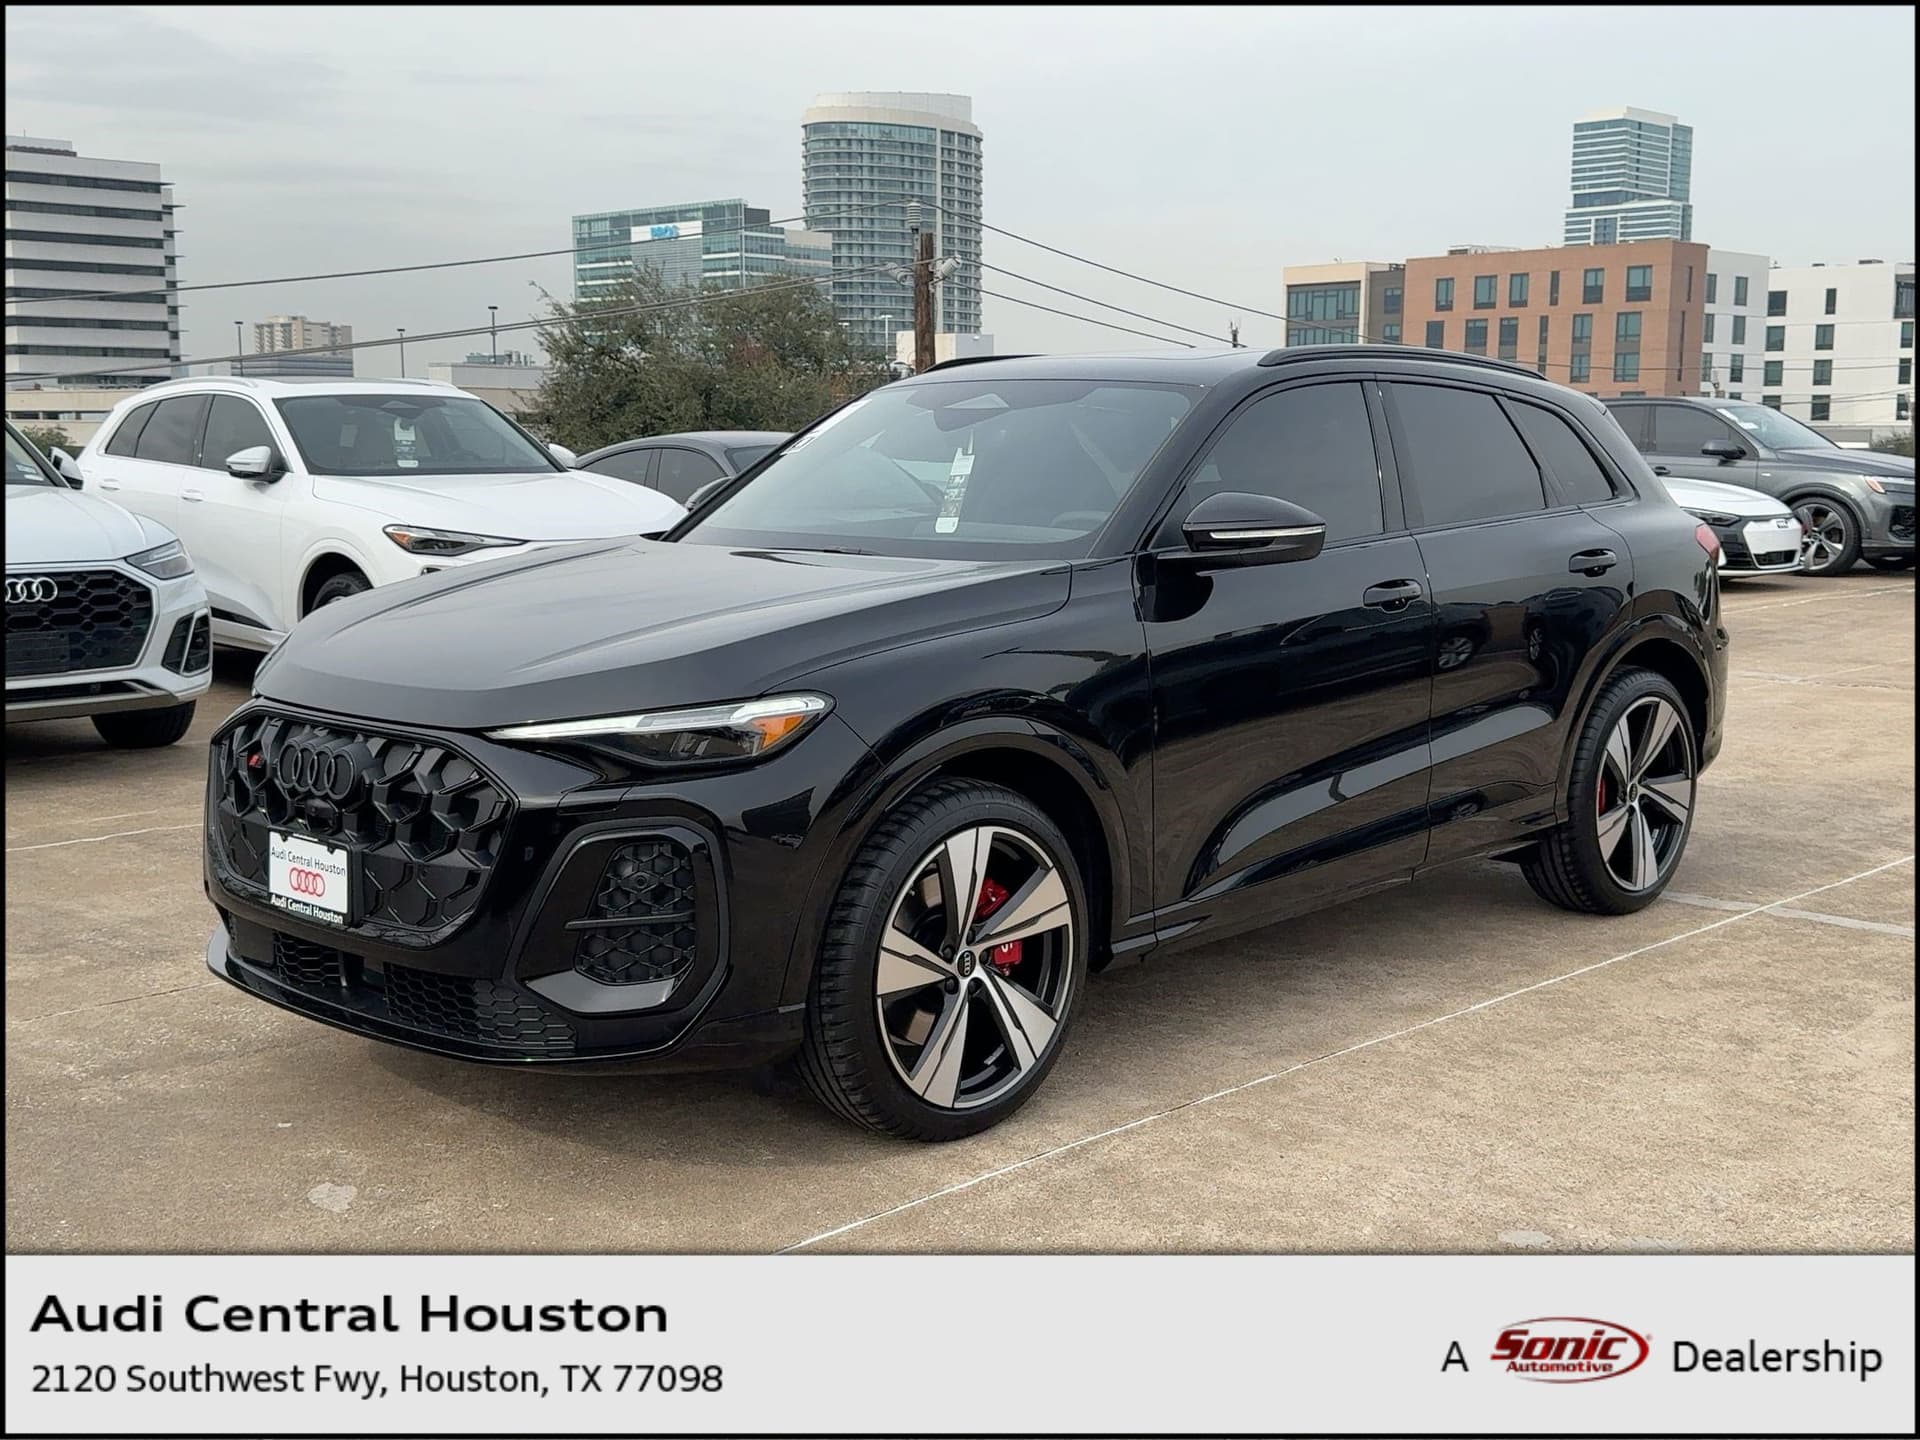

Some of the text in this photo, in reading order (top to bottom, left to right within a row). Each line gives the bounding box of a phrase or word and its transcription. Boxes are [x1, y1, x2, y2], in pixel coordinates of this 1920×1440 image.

[271, 846, 345, 876] Audi Central Houston
[271, 894, 343, 924] Audi Central Houston
